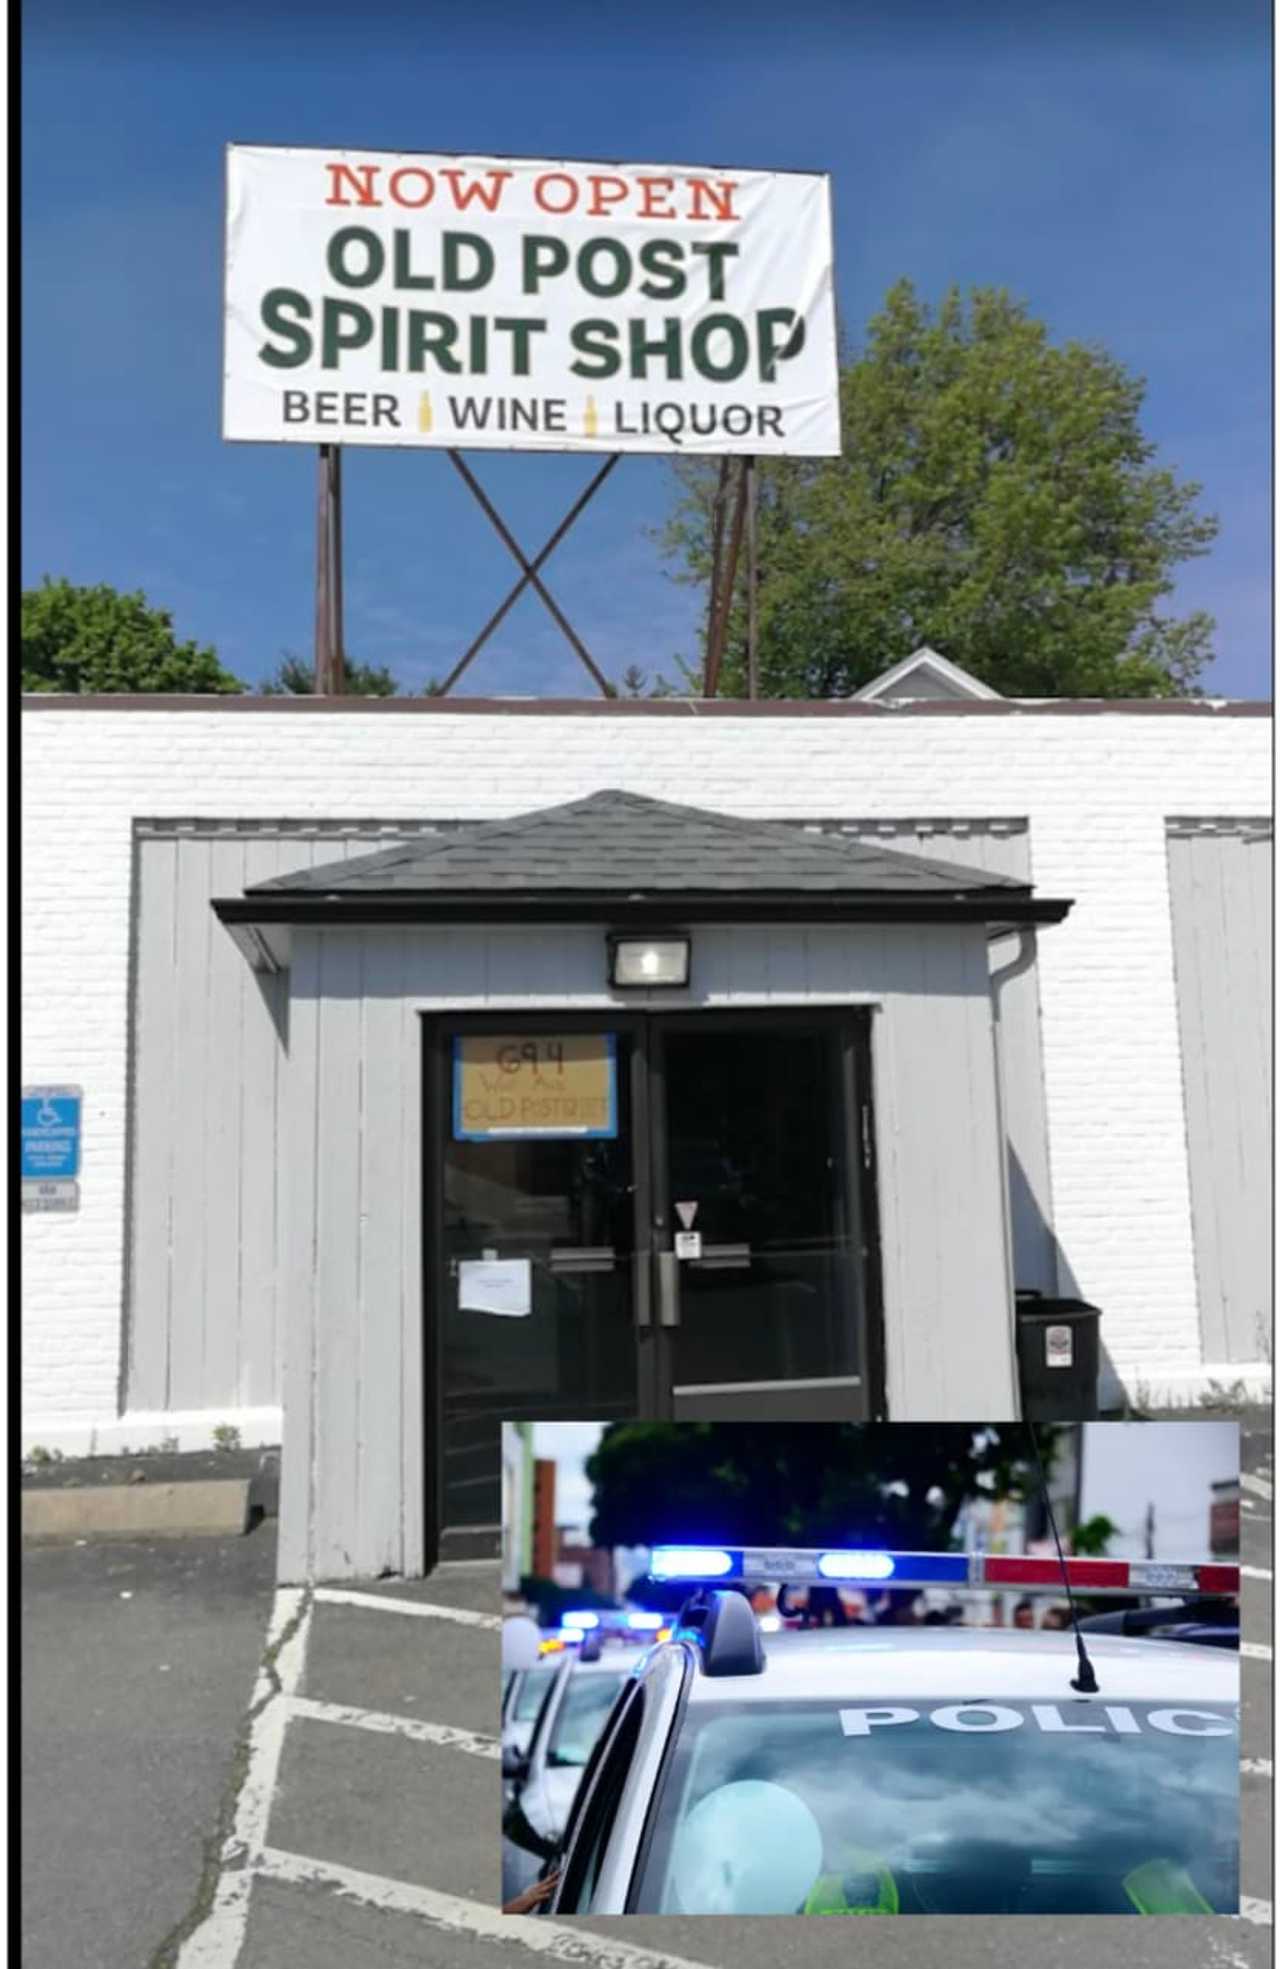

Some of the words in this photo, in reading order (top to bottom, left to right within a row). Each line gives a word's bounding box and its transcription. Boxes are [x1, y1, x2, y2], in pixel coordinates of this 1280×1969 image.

[326, 164, 513, 211] NOW
[534, 174, 740, 221] OPEN
[327, 226, 495, 291] OLD
[522, 234, 739, 302] POST
[258, 288, 547, 376] SPIRIT
[570, 308, 806, 383] SHOP
[283, 390, 401, 427] BEER
[449, 397, 567, 432] WINE
[615, 402, 785, 444] LIQUOR
[838, 1703, 1241, 1738] POLIC
